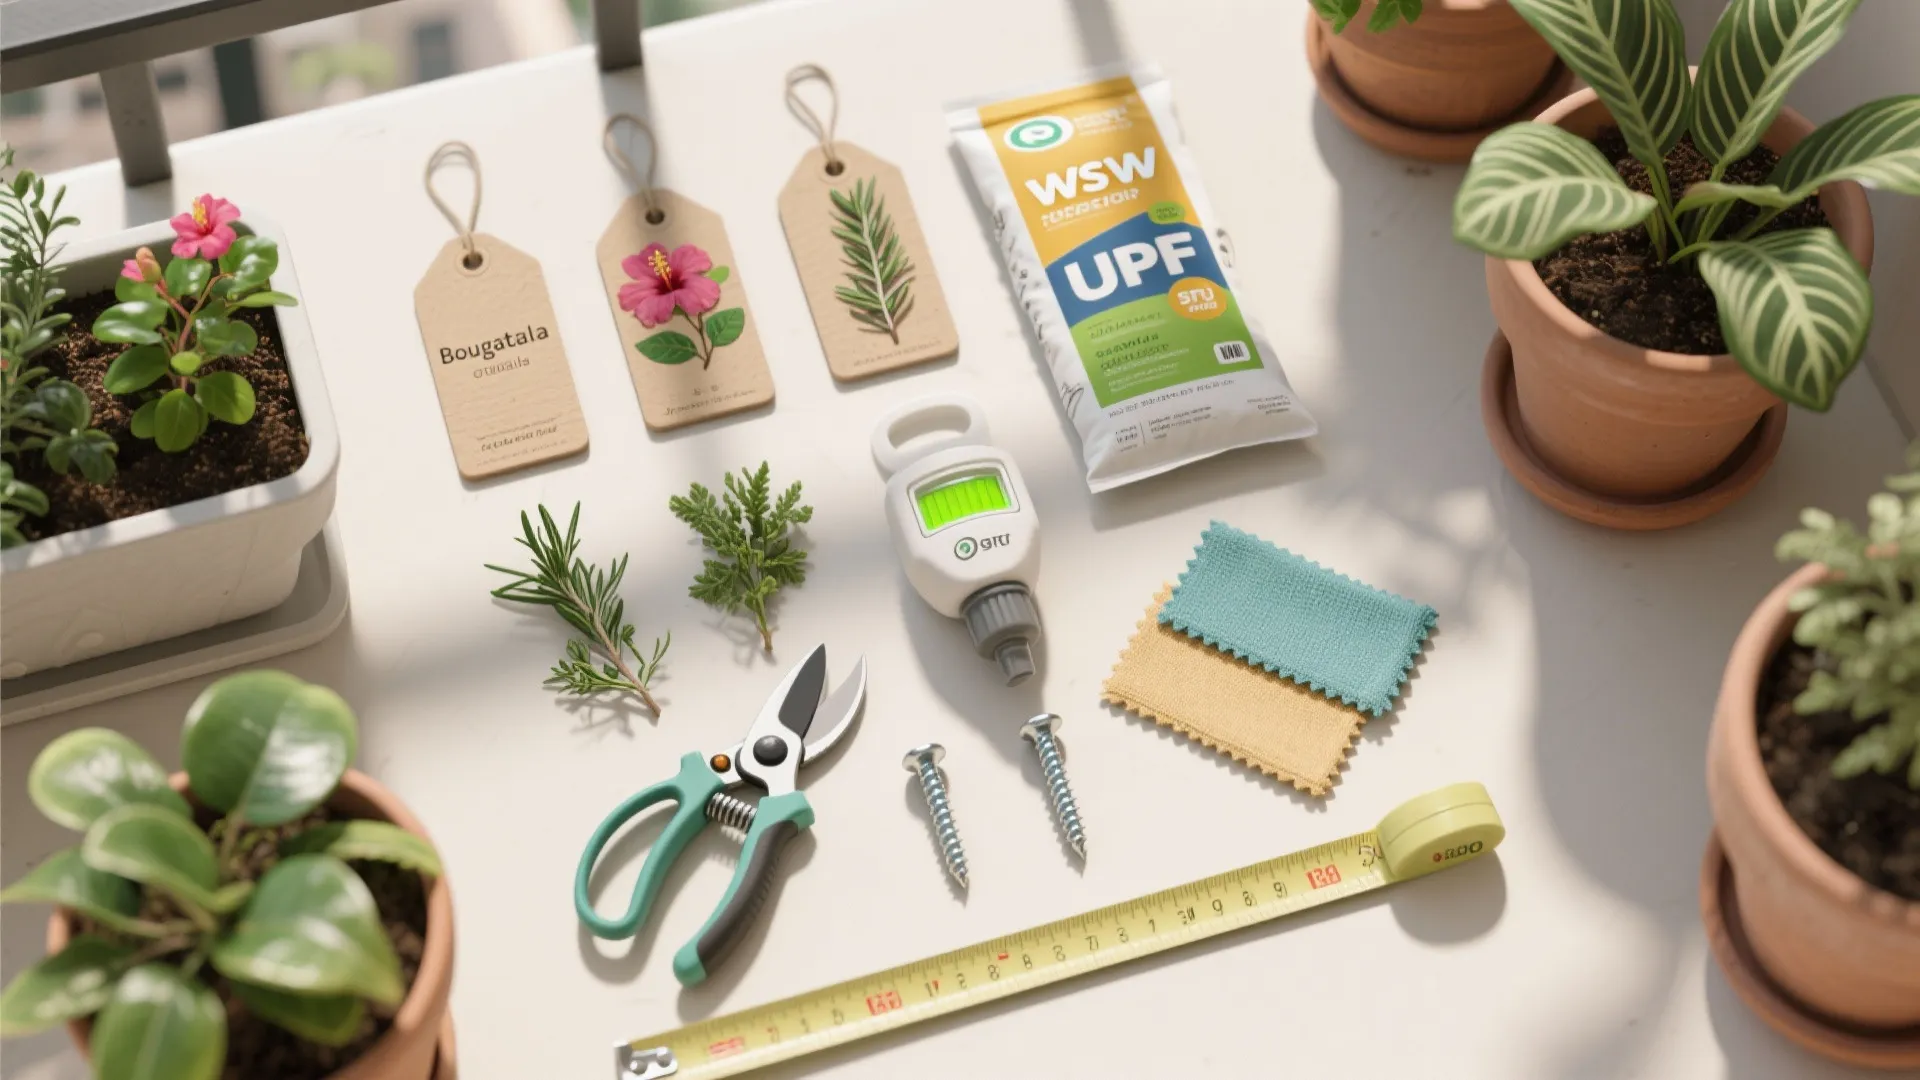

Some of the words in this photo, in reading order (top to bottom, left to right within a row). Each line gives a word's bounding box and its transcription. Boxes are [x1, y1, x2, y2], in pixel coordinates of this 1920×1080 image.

[1025, 147, 1155, 206] WSW
[1064, 231, 1196, 301] UPF
[439, 325, 549, 365] Bougatala
